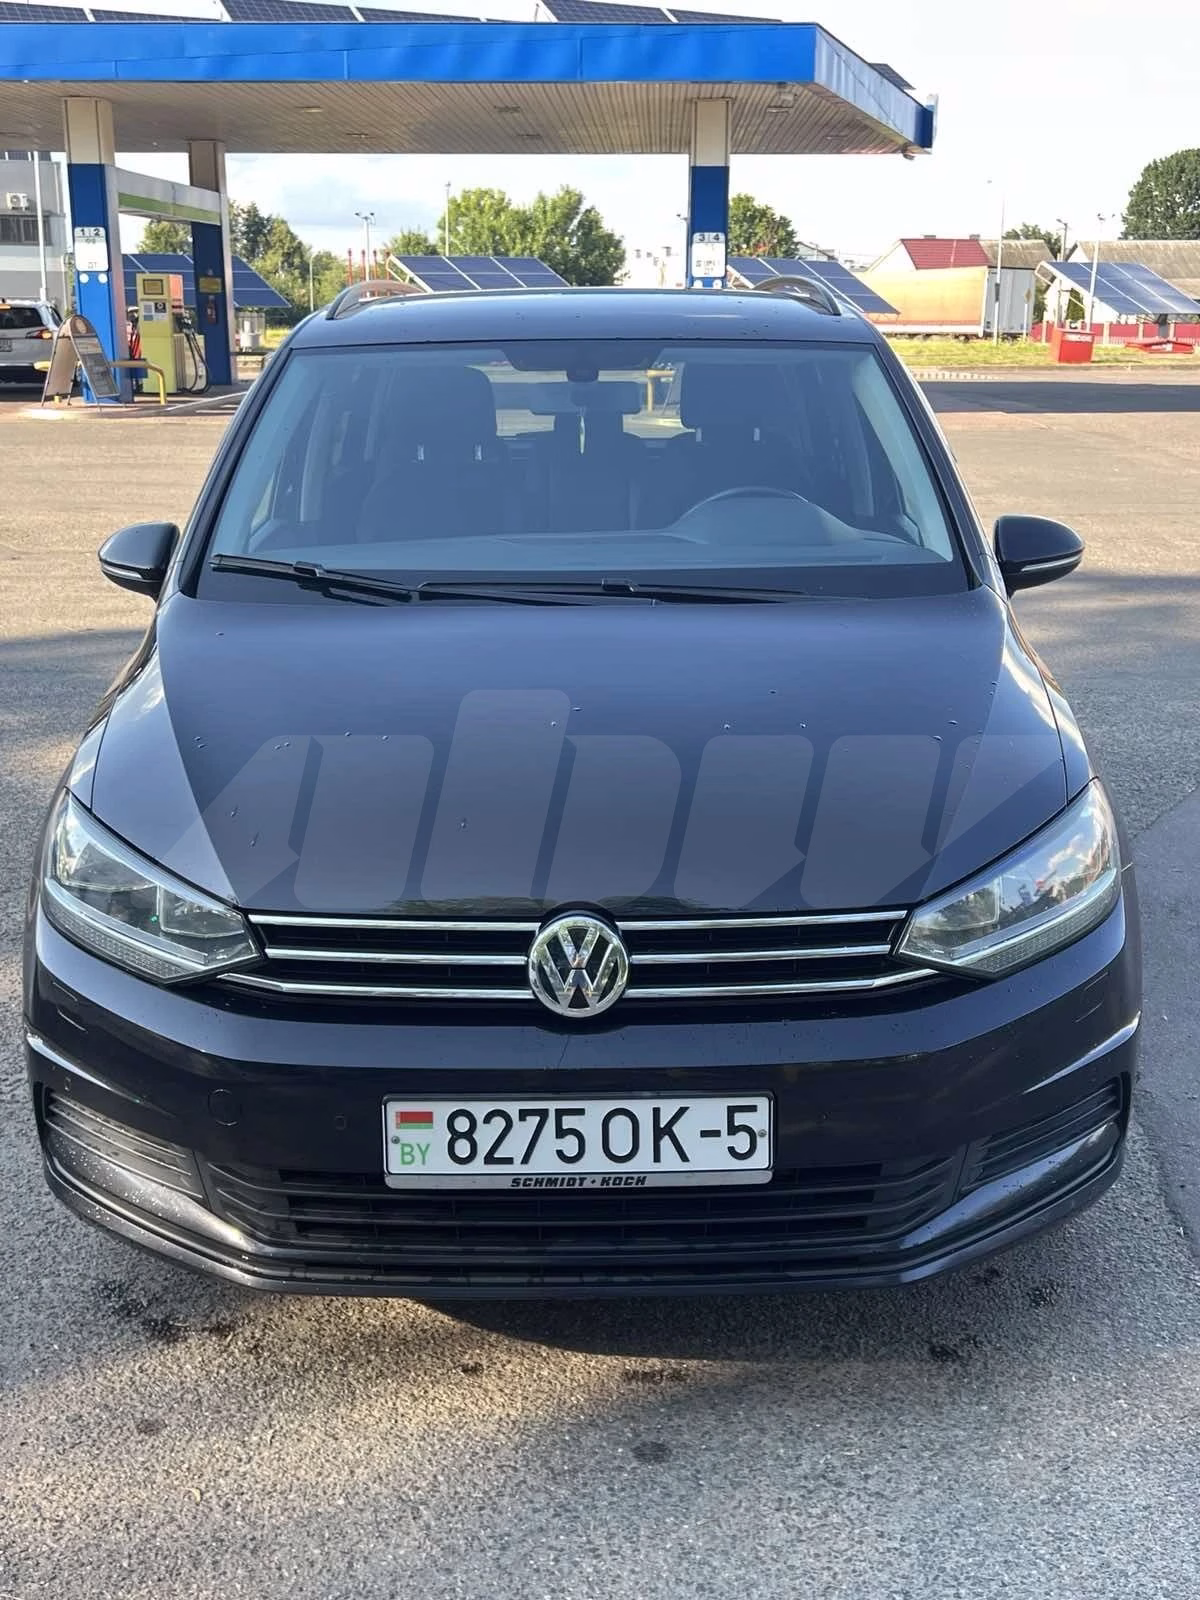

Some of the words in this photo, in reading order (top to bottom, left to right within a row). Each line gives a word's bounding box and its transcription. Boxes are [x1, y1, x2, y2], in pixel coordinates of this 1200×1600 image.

[93, 228, 100, 236] 2
[698, 233, 705, 241] 3
[712, 233, 720, 241] 4
[399, 1143, 430, 1166] BY
[510, 1176, 587, 1188] SCHMIDT
[600, 1175, 647, 1187] KOCH
